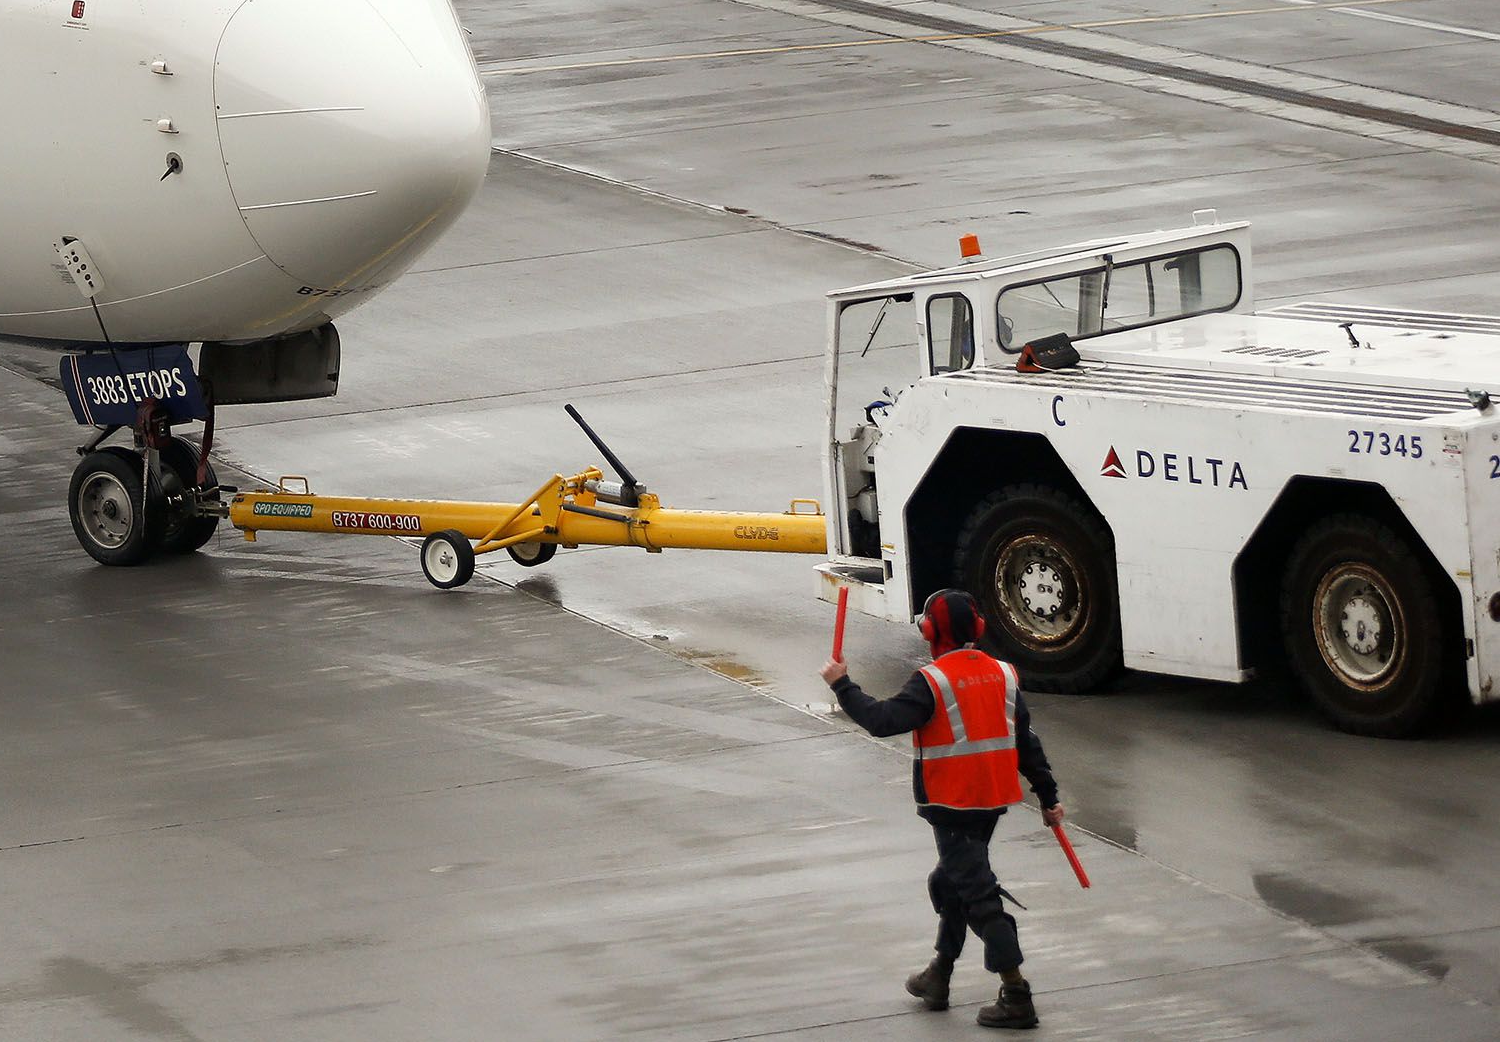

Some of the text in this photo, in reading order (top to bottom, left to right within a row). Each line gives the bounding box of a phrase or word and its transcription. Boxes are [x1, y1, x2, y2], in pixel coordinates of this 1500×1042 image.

[87, 367, 187, 405] 3883 ETOPS
[1051, 395, 1066, 426] C
[1347, 430, 1423, 458] 27345
[1136, 450, 1248, 490] DELTA
[1489, 455, 1500, 479] 2
[254, 503, 312, 516] SPD EQUIPPED
[333, 512, 420, 530] B737 600-900
